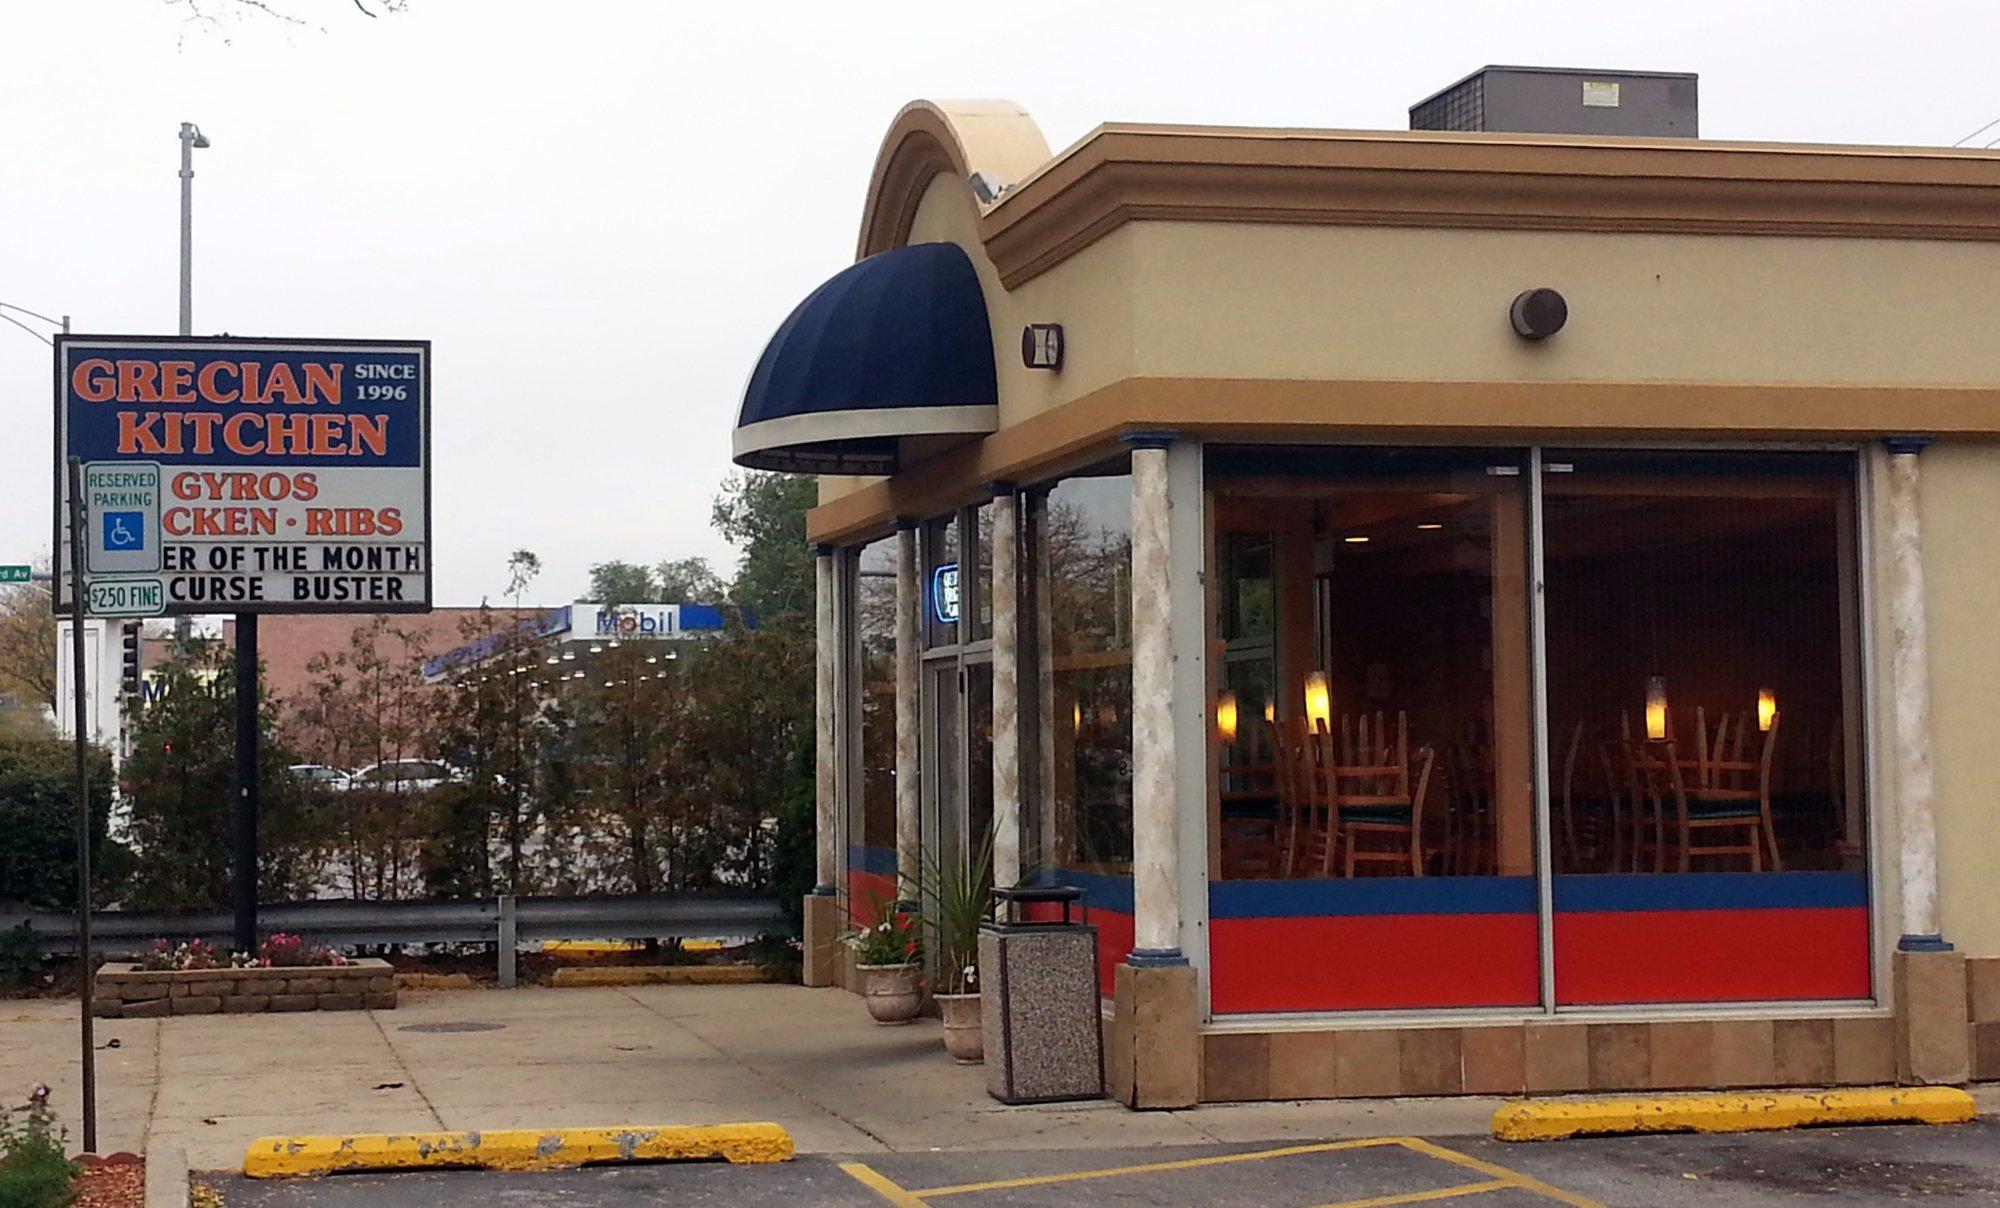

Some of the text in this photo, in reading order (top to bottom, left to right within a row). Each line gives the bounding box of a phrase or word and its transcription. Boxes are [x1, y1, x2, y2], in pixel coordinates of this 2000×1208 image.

[72, 358, 344, 404] GRECIAN
[354, 364, 416, 380] SINCE
[356, 385, 407, 400] 1996
[116, 411, 389, 455] KITCHEN
[89, 472, 156, 488] RESERVED
[171, 471, 319, 501] GYROS
[94, 492, 152, 506] PARKING
[162, 506, 403, 536] CKEN RIBS
[162, 546, 421, 571] ER OF THE MONTH
[0, 569, 8, 579] d
[91, 585, 159, 608] $250 FINE
[169, 576, 404, 601] CURSE BUSTER
[596, 610, 673, 632] Mobil
